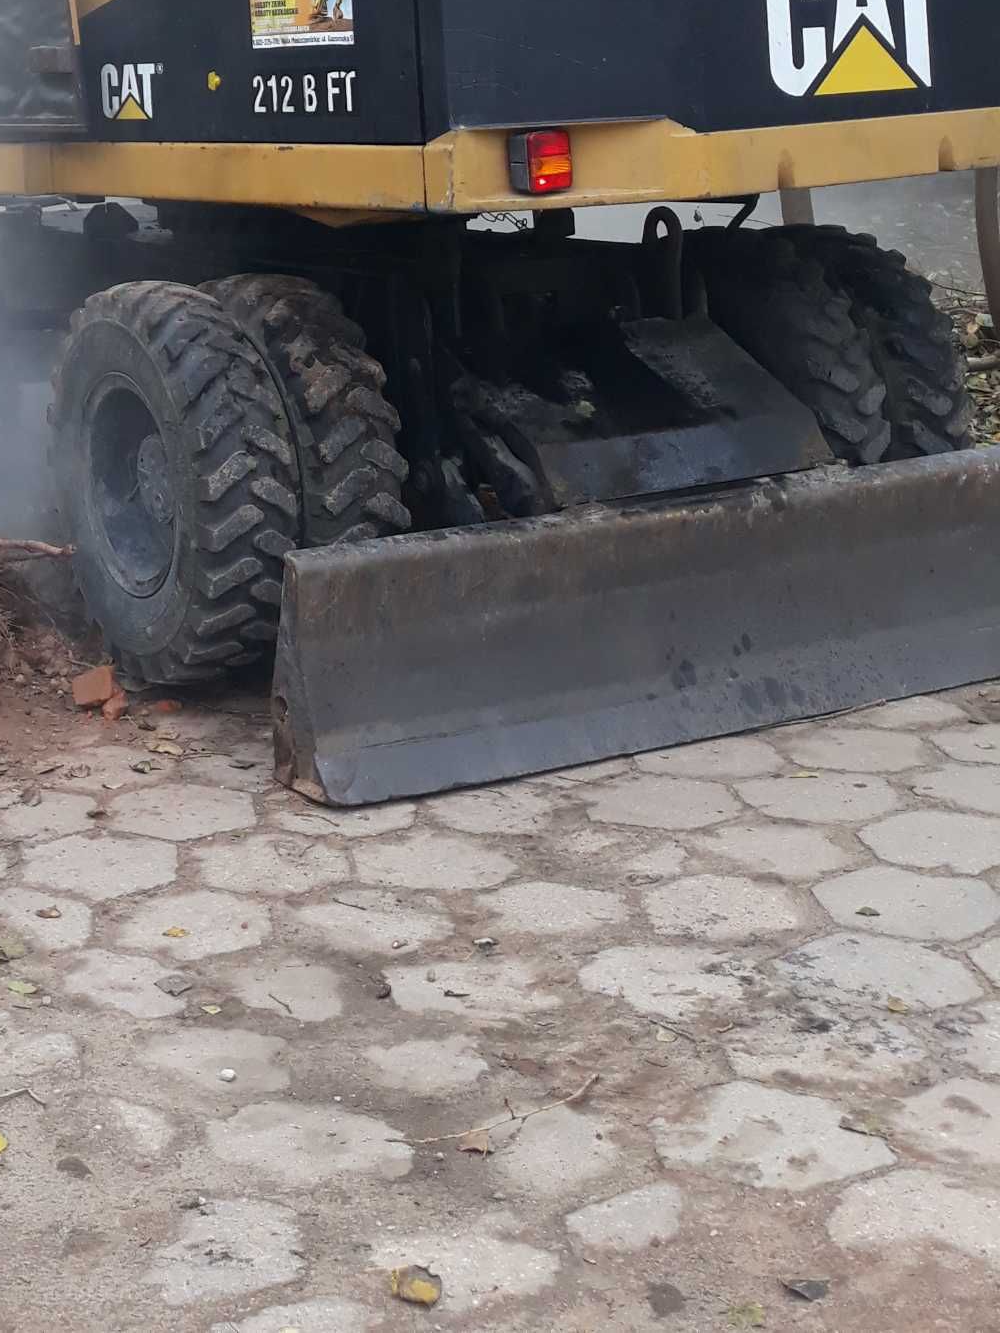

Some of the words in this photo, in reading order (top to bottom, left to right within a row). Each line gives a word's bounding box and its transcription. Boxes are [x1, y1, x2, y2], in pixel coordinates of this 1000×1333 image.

[252, 74, 295, 113] 212
[302, 73, 318, 113] B
[326, 70, 356, 113] FT
